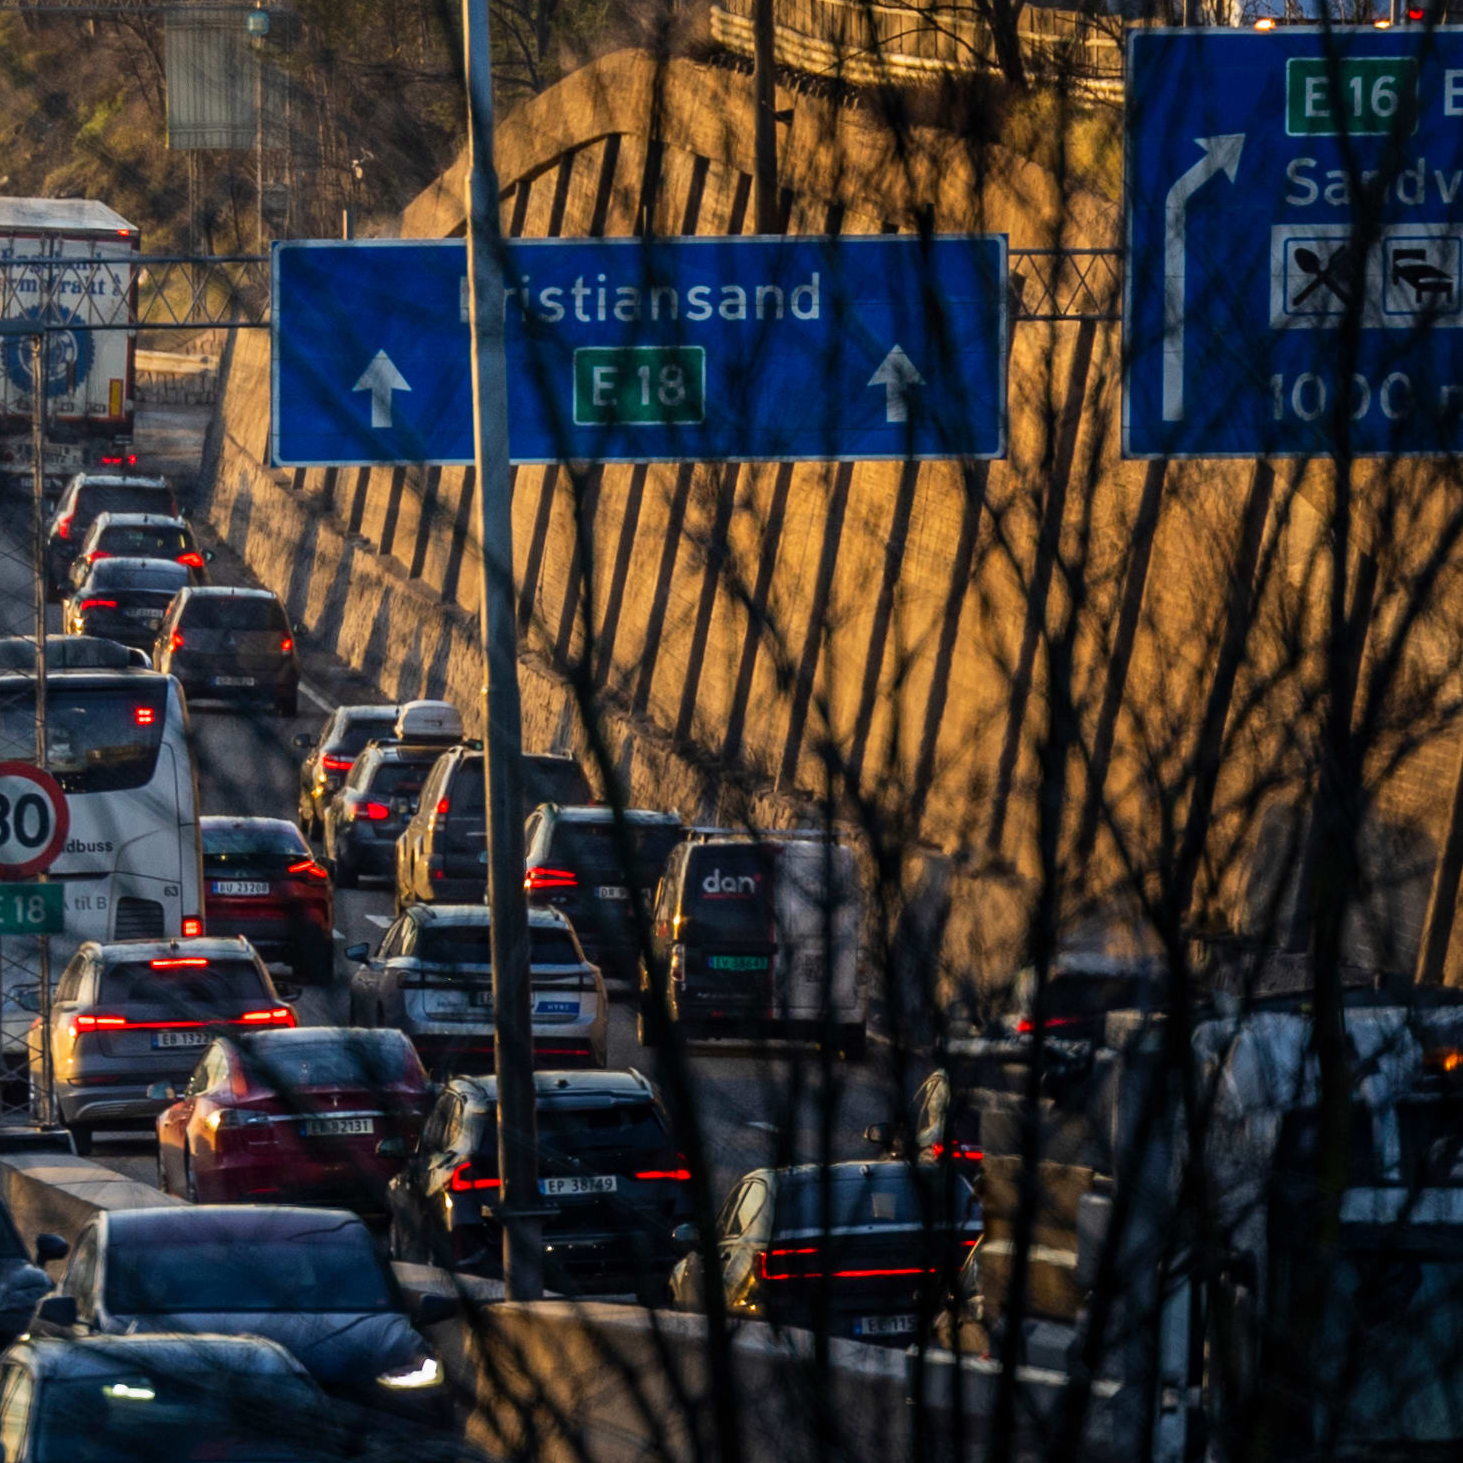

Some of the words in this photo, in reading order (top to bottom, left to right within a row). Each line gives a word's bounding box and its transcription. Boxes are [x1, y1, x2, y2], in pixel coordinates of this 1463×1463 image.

[1305, 76, 1330, 117] E
[1349, 76, 1399, 117] 16
[592, 365, 618, 406] E
[636, 365, 687, 407] 18
[61, 839, 114, 853] dbuss
[702, 868, 756, 894] dan
[14, 895, 47, 924] 18
[74, 897, 92, 911] til
[96, 897, 107, 910] B
[549, 1180, 564, 1193] EP
